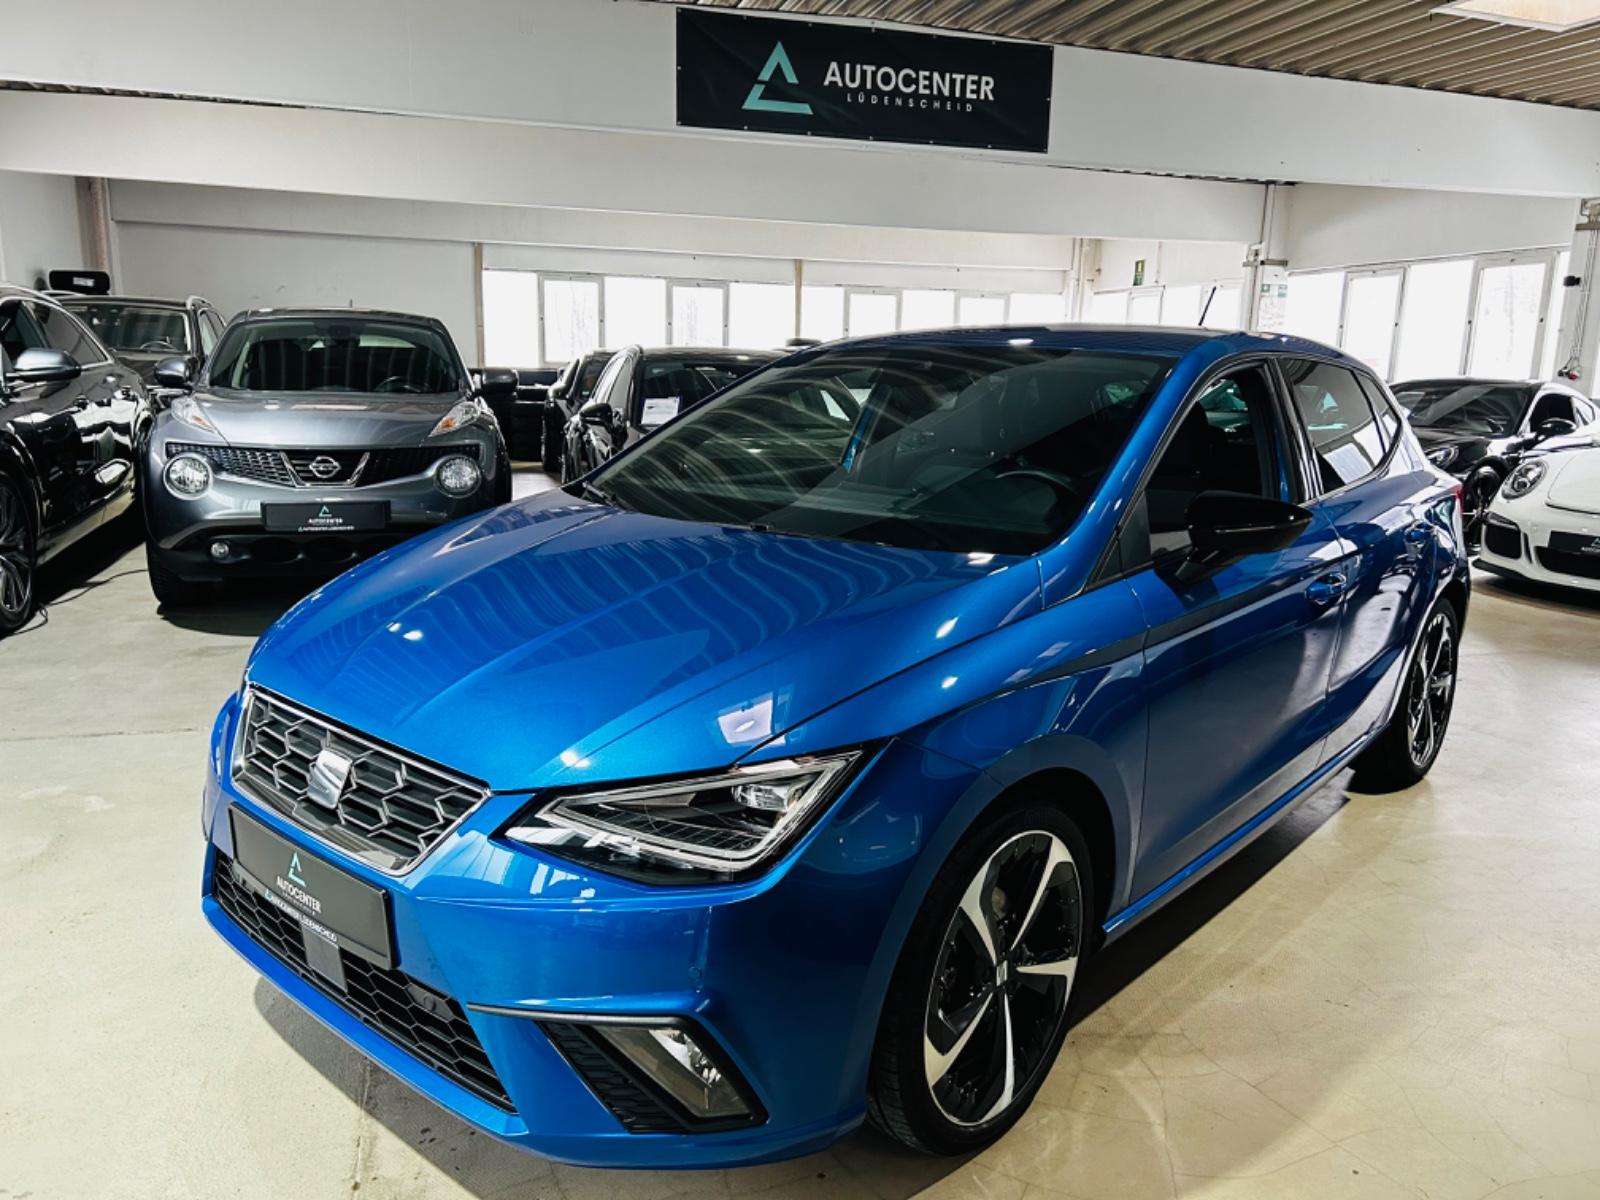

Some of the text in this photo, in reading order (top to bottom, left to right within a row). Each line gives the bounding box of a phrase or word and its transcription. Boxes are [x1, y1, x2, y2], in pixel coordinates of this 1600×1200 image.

[823, 61, 995, 101] AUTOCENTER
[847, 92, 973, 112] LÜDENSCHEID
[276, 875, 322, 914] AUTOCENTER
